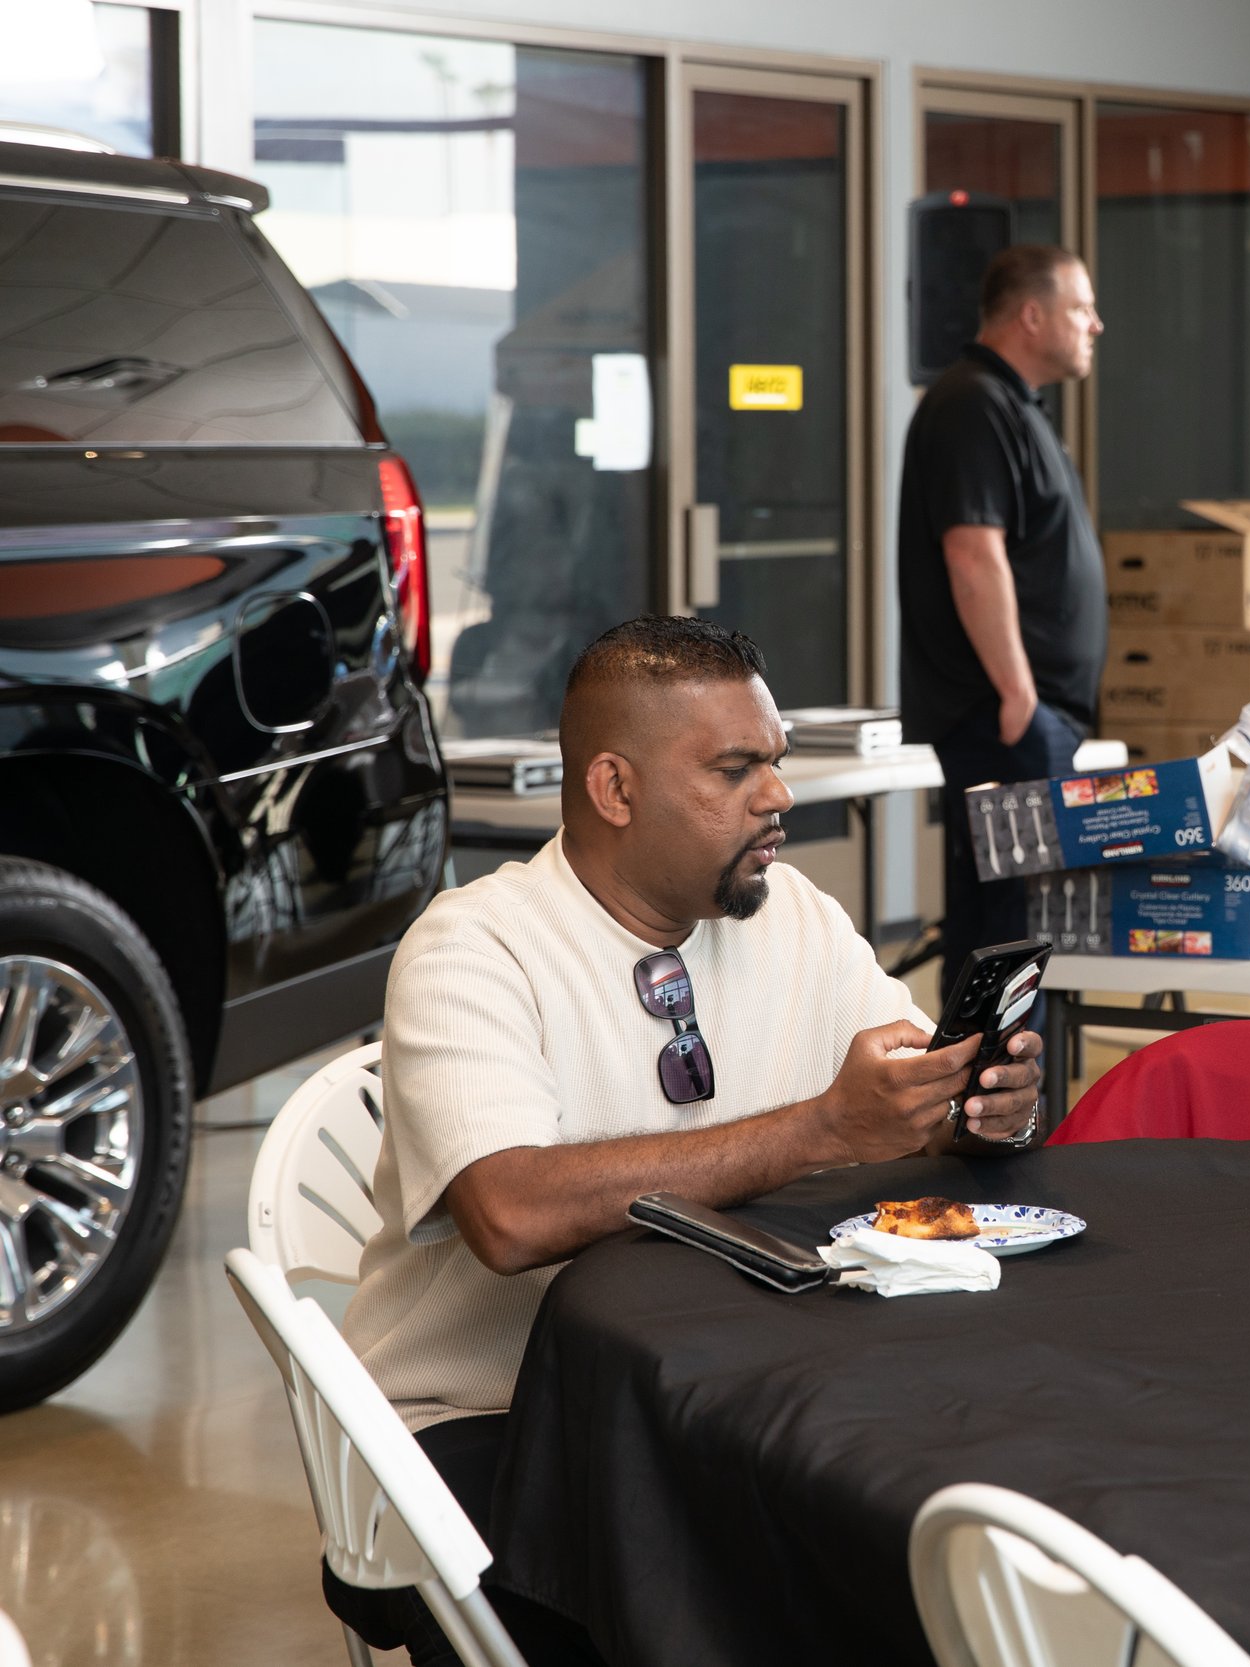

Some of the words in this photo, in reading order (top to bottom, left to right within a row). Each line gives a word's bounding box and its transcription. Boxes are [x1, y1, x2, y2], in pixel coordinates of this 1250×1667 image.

[1078, 830, 1109, 845] Cutlery
[1109, 829, 1131, 841] Clear
[1131, 824, 1161, 837] Crystal
[1175, 827, 1205, 846] 360
[1102, 843, 1144, 858] KIRKLAND
[1130, 890, 1157, 901] Crystal
[1159, 890, 1180, 901] Clear
[1181, 891, 1211, 903] Cutlery
